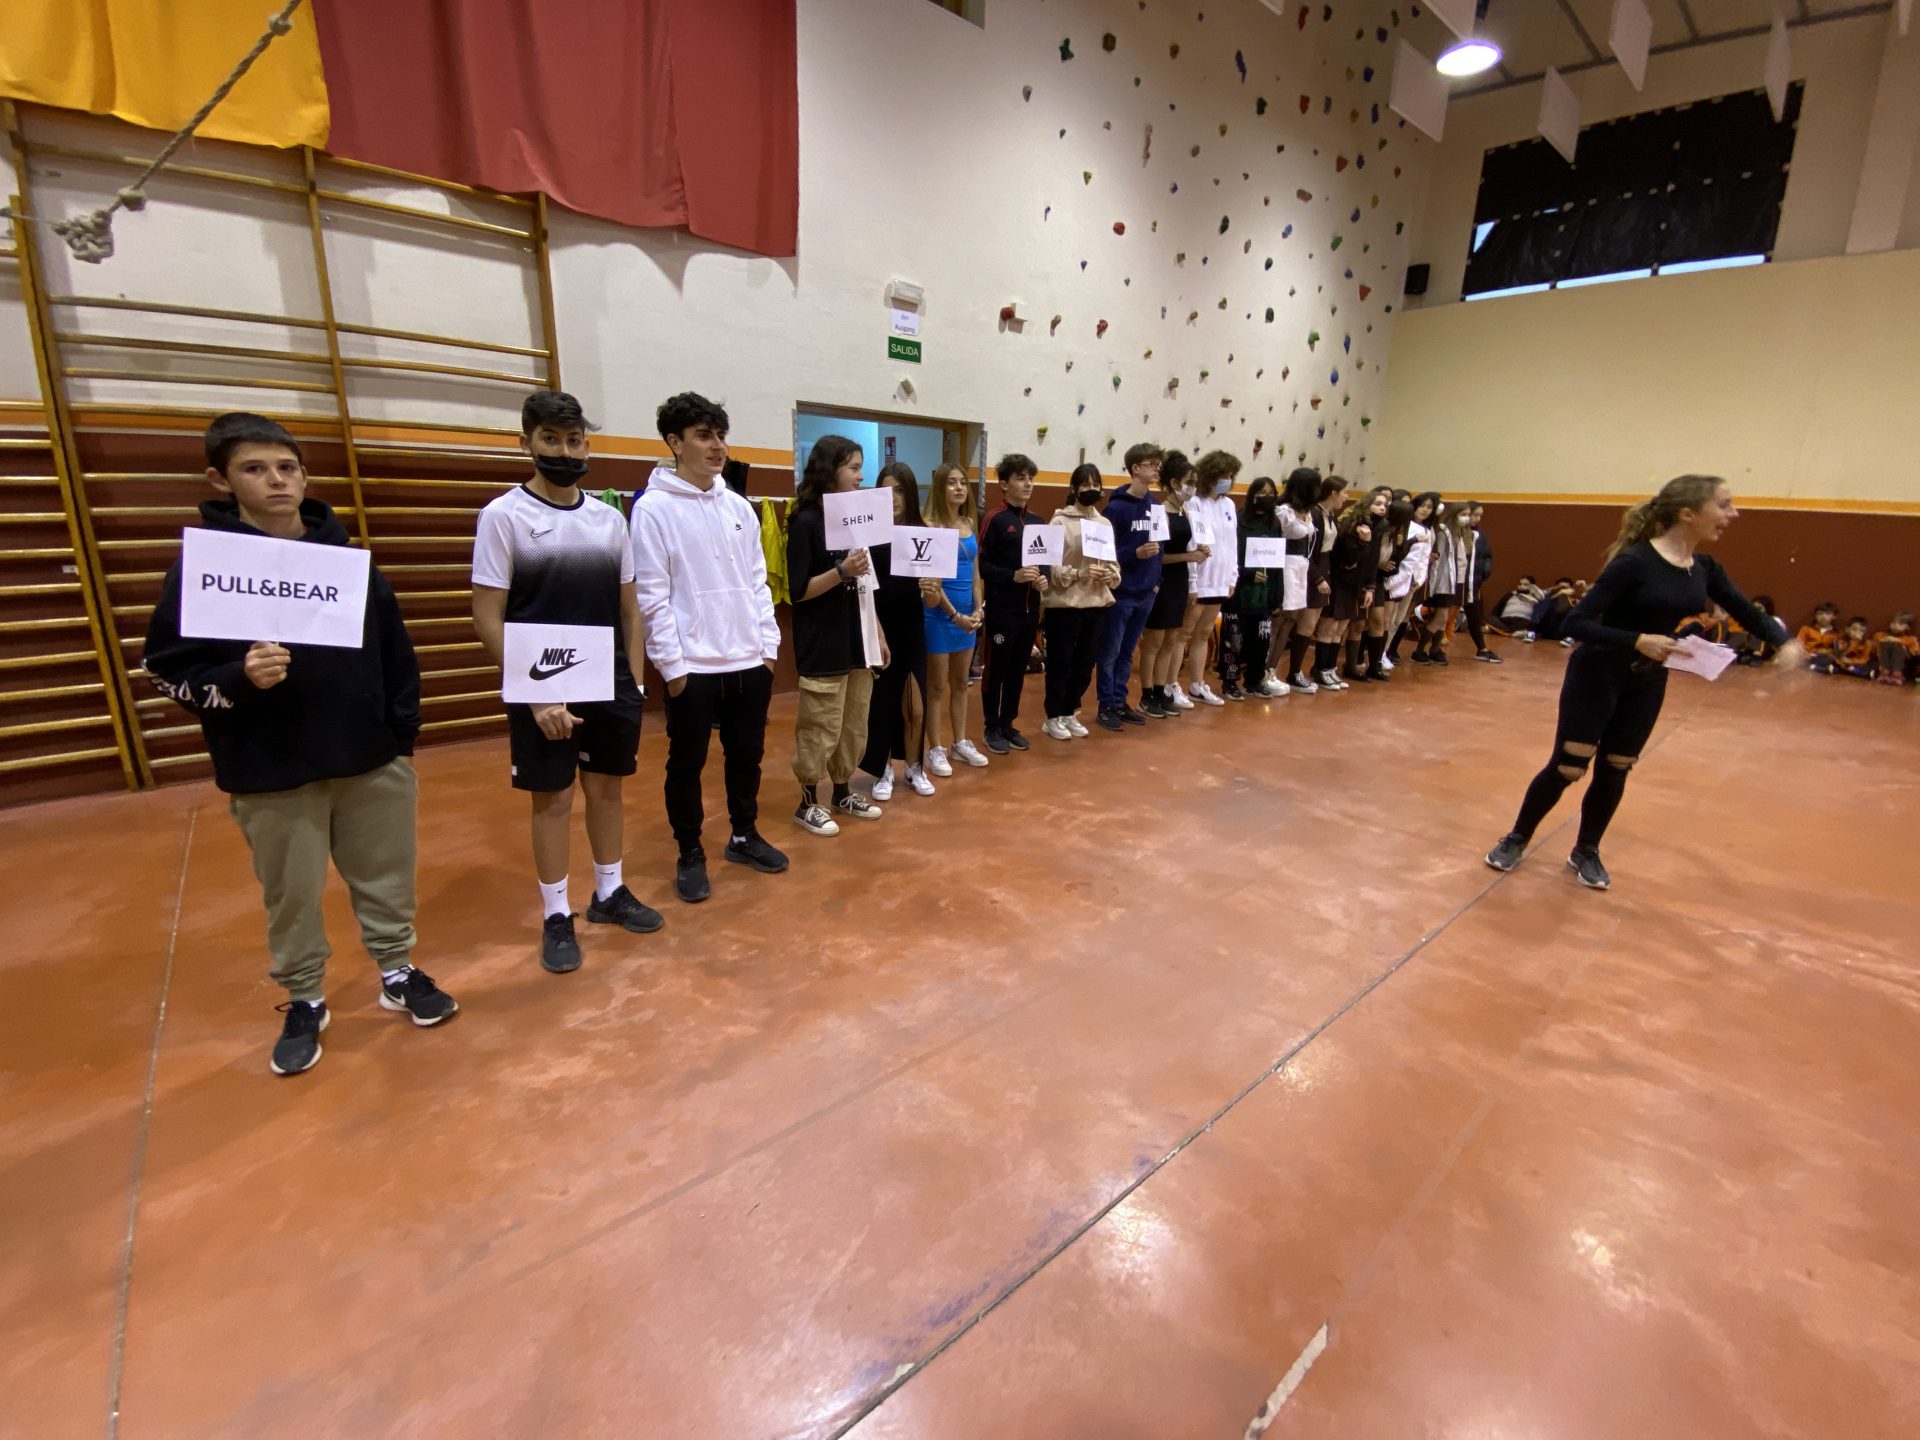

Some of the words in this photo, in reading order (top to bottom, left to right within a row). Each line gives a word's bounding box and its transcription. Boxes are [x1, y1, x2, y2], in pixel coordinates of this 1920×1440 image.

[891, 343, 919, 357] SALIDA
[842, 514, 874, 526] SHEIN
[1027, 547, 1047, 555] adidas
[202, 573, 339, 602] PULL&BEAR
[539, 648, 577, 666] NIKE
